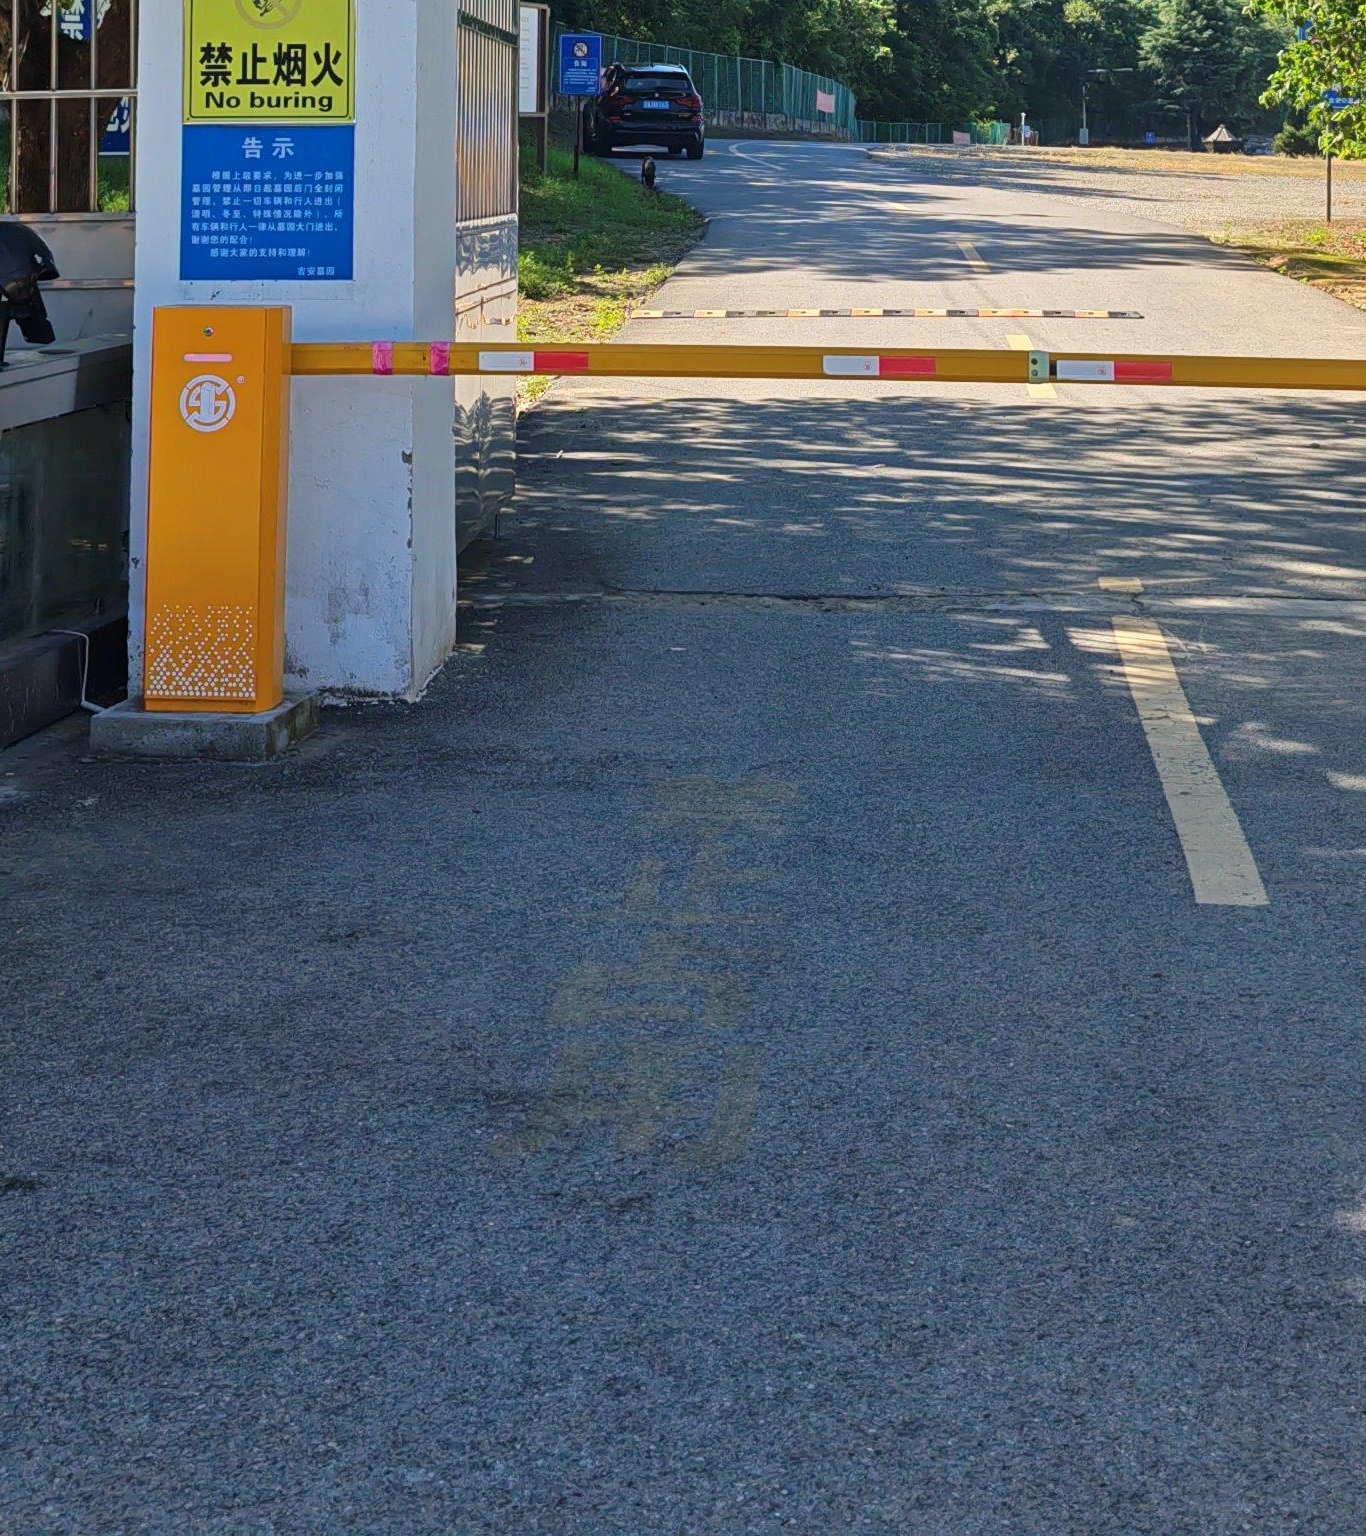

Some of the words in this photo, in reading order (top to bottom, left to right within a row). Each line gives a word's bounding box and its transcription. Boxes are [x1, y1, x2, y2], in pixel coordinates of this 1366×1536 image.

[199, 42, 344, 88] 禁止烟火
[205, 91, 241, 109] No
[250, 91, 333, 113] buring
[241, 136, 295, 159] 告示
[297, 266, 336, 276] 吉安墓园
